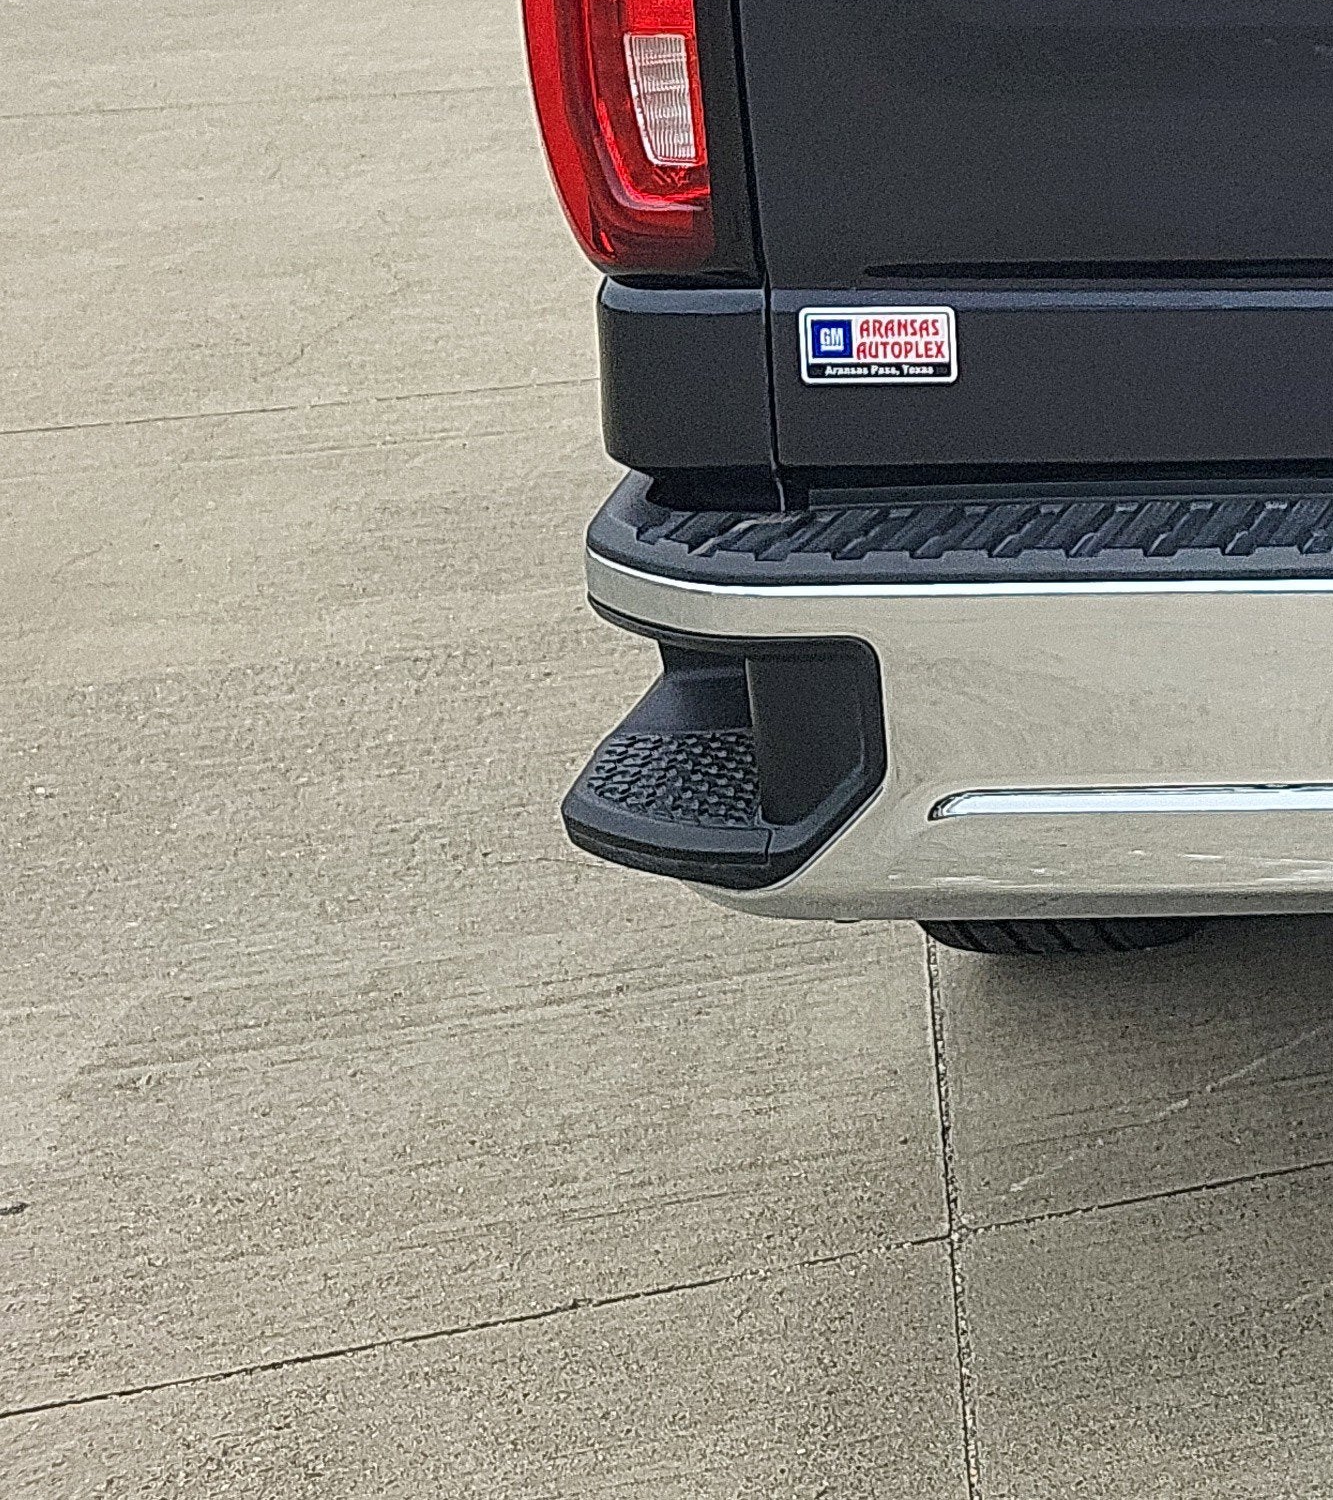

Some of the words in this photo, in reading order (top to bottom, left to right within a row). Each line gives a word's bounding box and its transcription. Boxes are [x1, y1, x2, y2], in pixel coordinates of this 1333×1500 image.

[859, 318, 940, 339] ARANSAS
[819, 327, 845, 351] GM
[856, 340, 946, 360] AUTOPLEX
[901, 364, 935, 375] Texas
